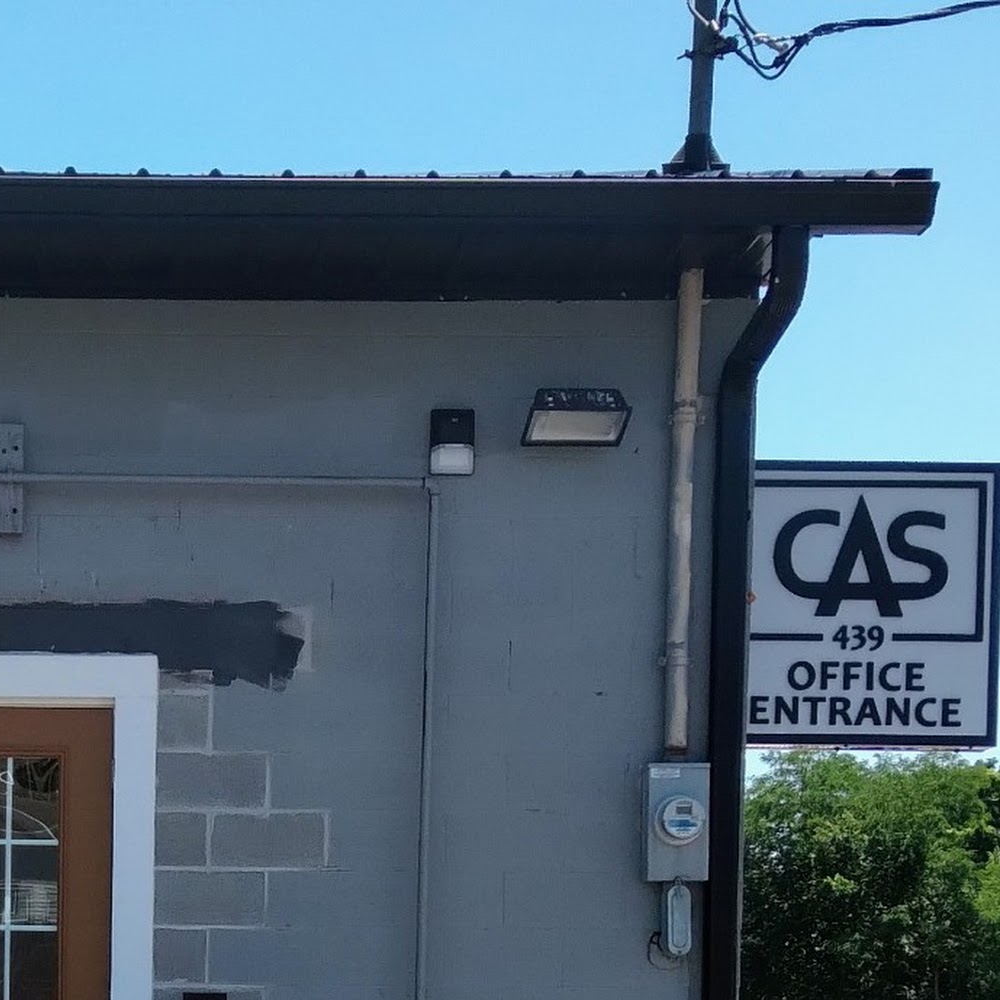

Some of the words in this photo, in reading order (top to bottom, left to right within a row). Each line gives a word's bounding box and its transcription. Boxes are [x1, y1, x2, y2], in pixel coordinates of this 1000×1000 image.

[773, 494, 949, 617] CAS
[832, 625, 885, 651] 439
[787, 661, 925, 691] OFFICE
[749, 696, 961, 727] ENTRANCE
